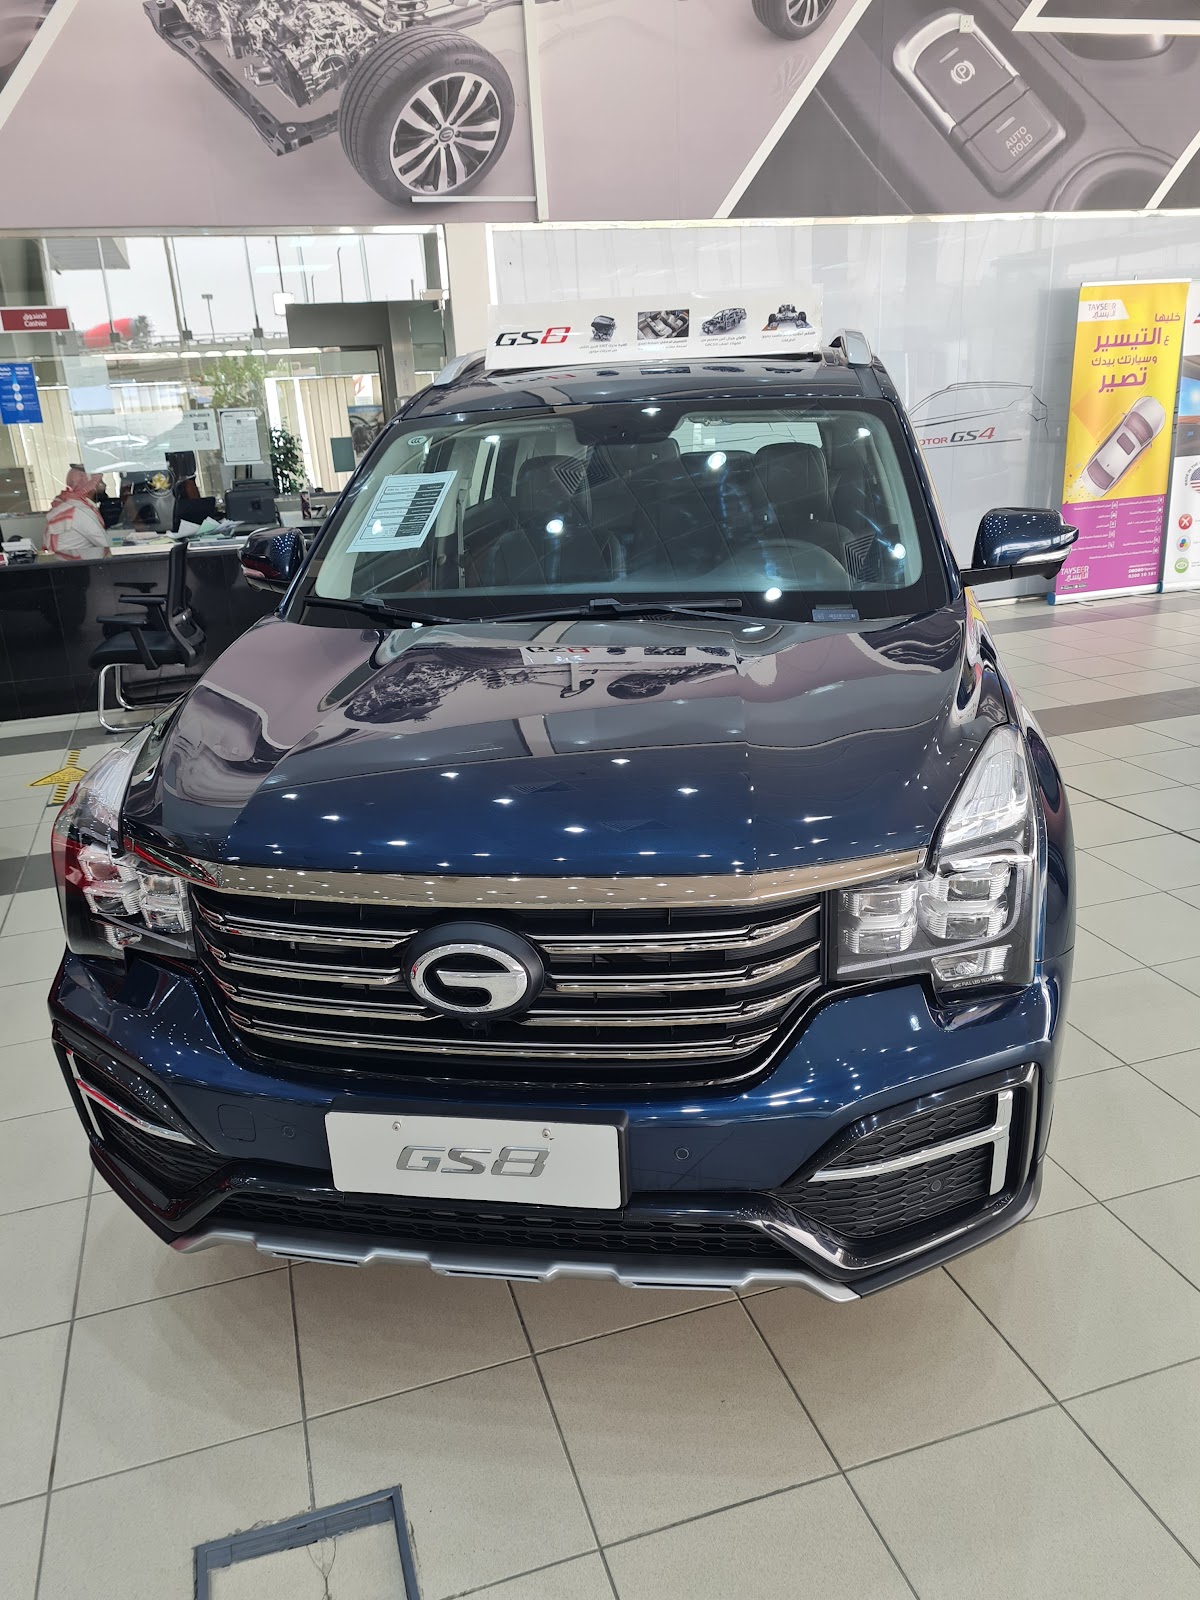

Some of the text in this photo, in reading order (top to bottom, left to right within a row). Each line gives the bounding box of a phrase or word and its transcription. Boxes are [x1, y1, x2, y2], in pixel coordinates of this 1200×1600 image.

[1005, 126, 1027, 149] AUTO
[1010, 133, 1033, 157] HOLD
[1088, 302, 1116, 311] TAYSEER
[1154, 312, 1181, 323] خليها
[495, 326, 571, 346] GS8
[1093, 327, 1162, 353] التيسير
[1091, 355, 1158, 367] وسيارتك بيدك
[1098, 367, 1148, 393] تصير
[949, 427, 996, 442] GS4
[1061, 565, 1089, 576] TAYSEER
[396, 1145, 551, 1178] GS8
